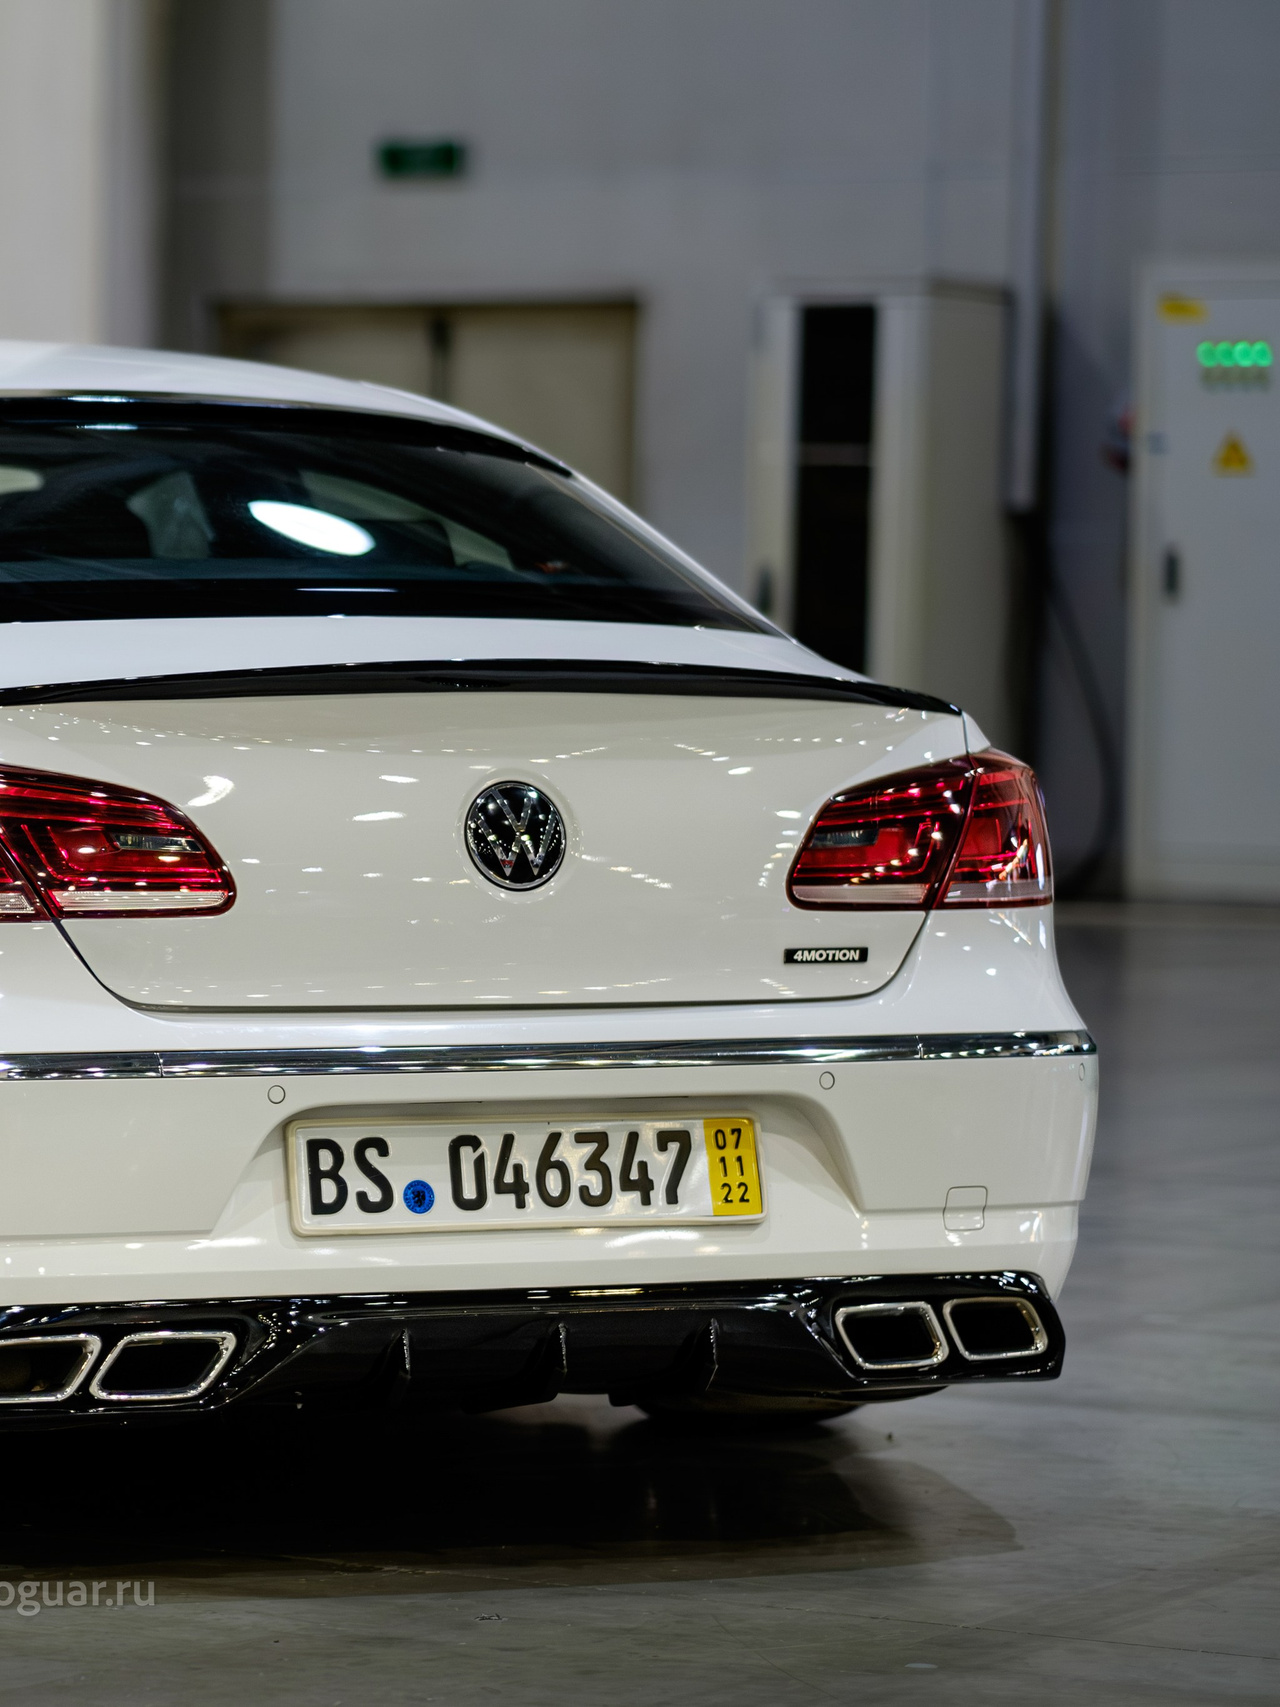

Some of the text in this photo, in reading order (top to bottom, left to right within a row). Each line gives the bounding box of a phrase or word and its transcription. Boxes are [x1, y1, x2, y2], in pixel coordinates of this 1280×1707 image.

[793, 949, 860, 961] 4MOTION
[714, 1127, 742, 1151] 07
[306, 1136, 395, 1216] BS
[448, 1130, 693, 1212] 046347
[719, 1155, 744, 1178] 11
[721, 1182, 750, 1204] 22
